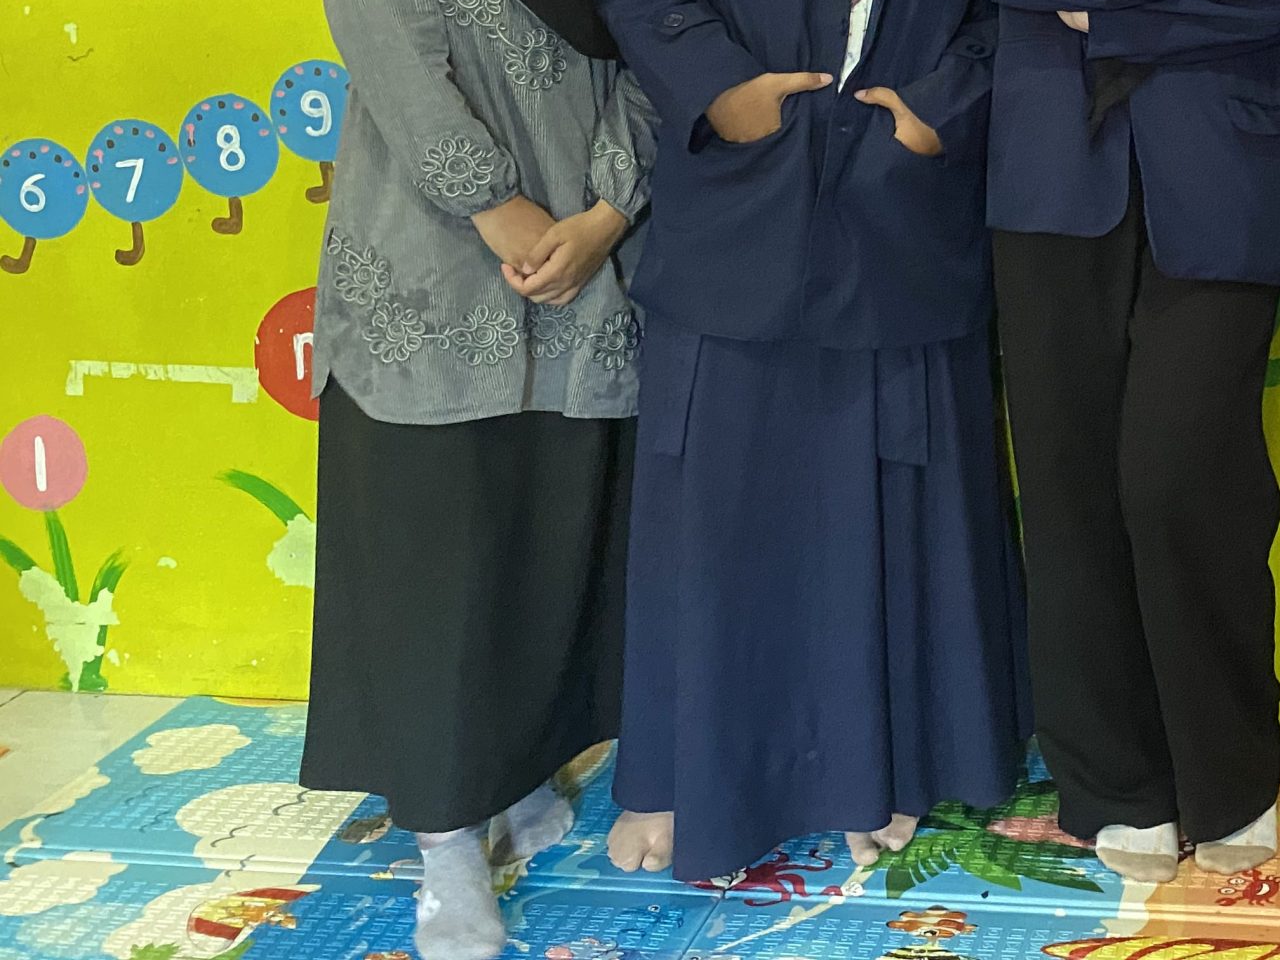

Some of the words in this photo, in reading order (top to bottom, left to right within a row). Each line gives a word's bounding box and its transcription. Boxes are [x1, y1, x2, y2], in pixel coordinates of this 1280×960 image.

[20, 173, 46, 212] 6
[115, 158, 144, 203] 7
[216, 124, 245, 171] 8
[301, 90, 331, 136] 9
